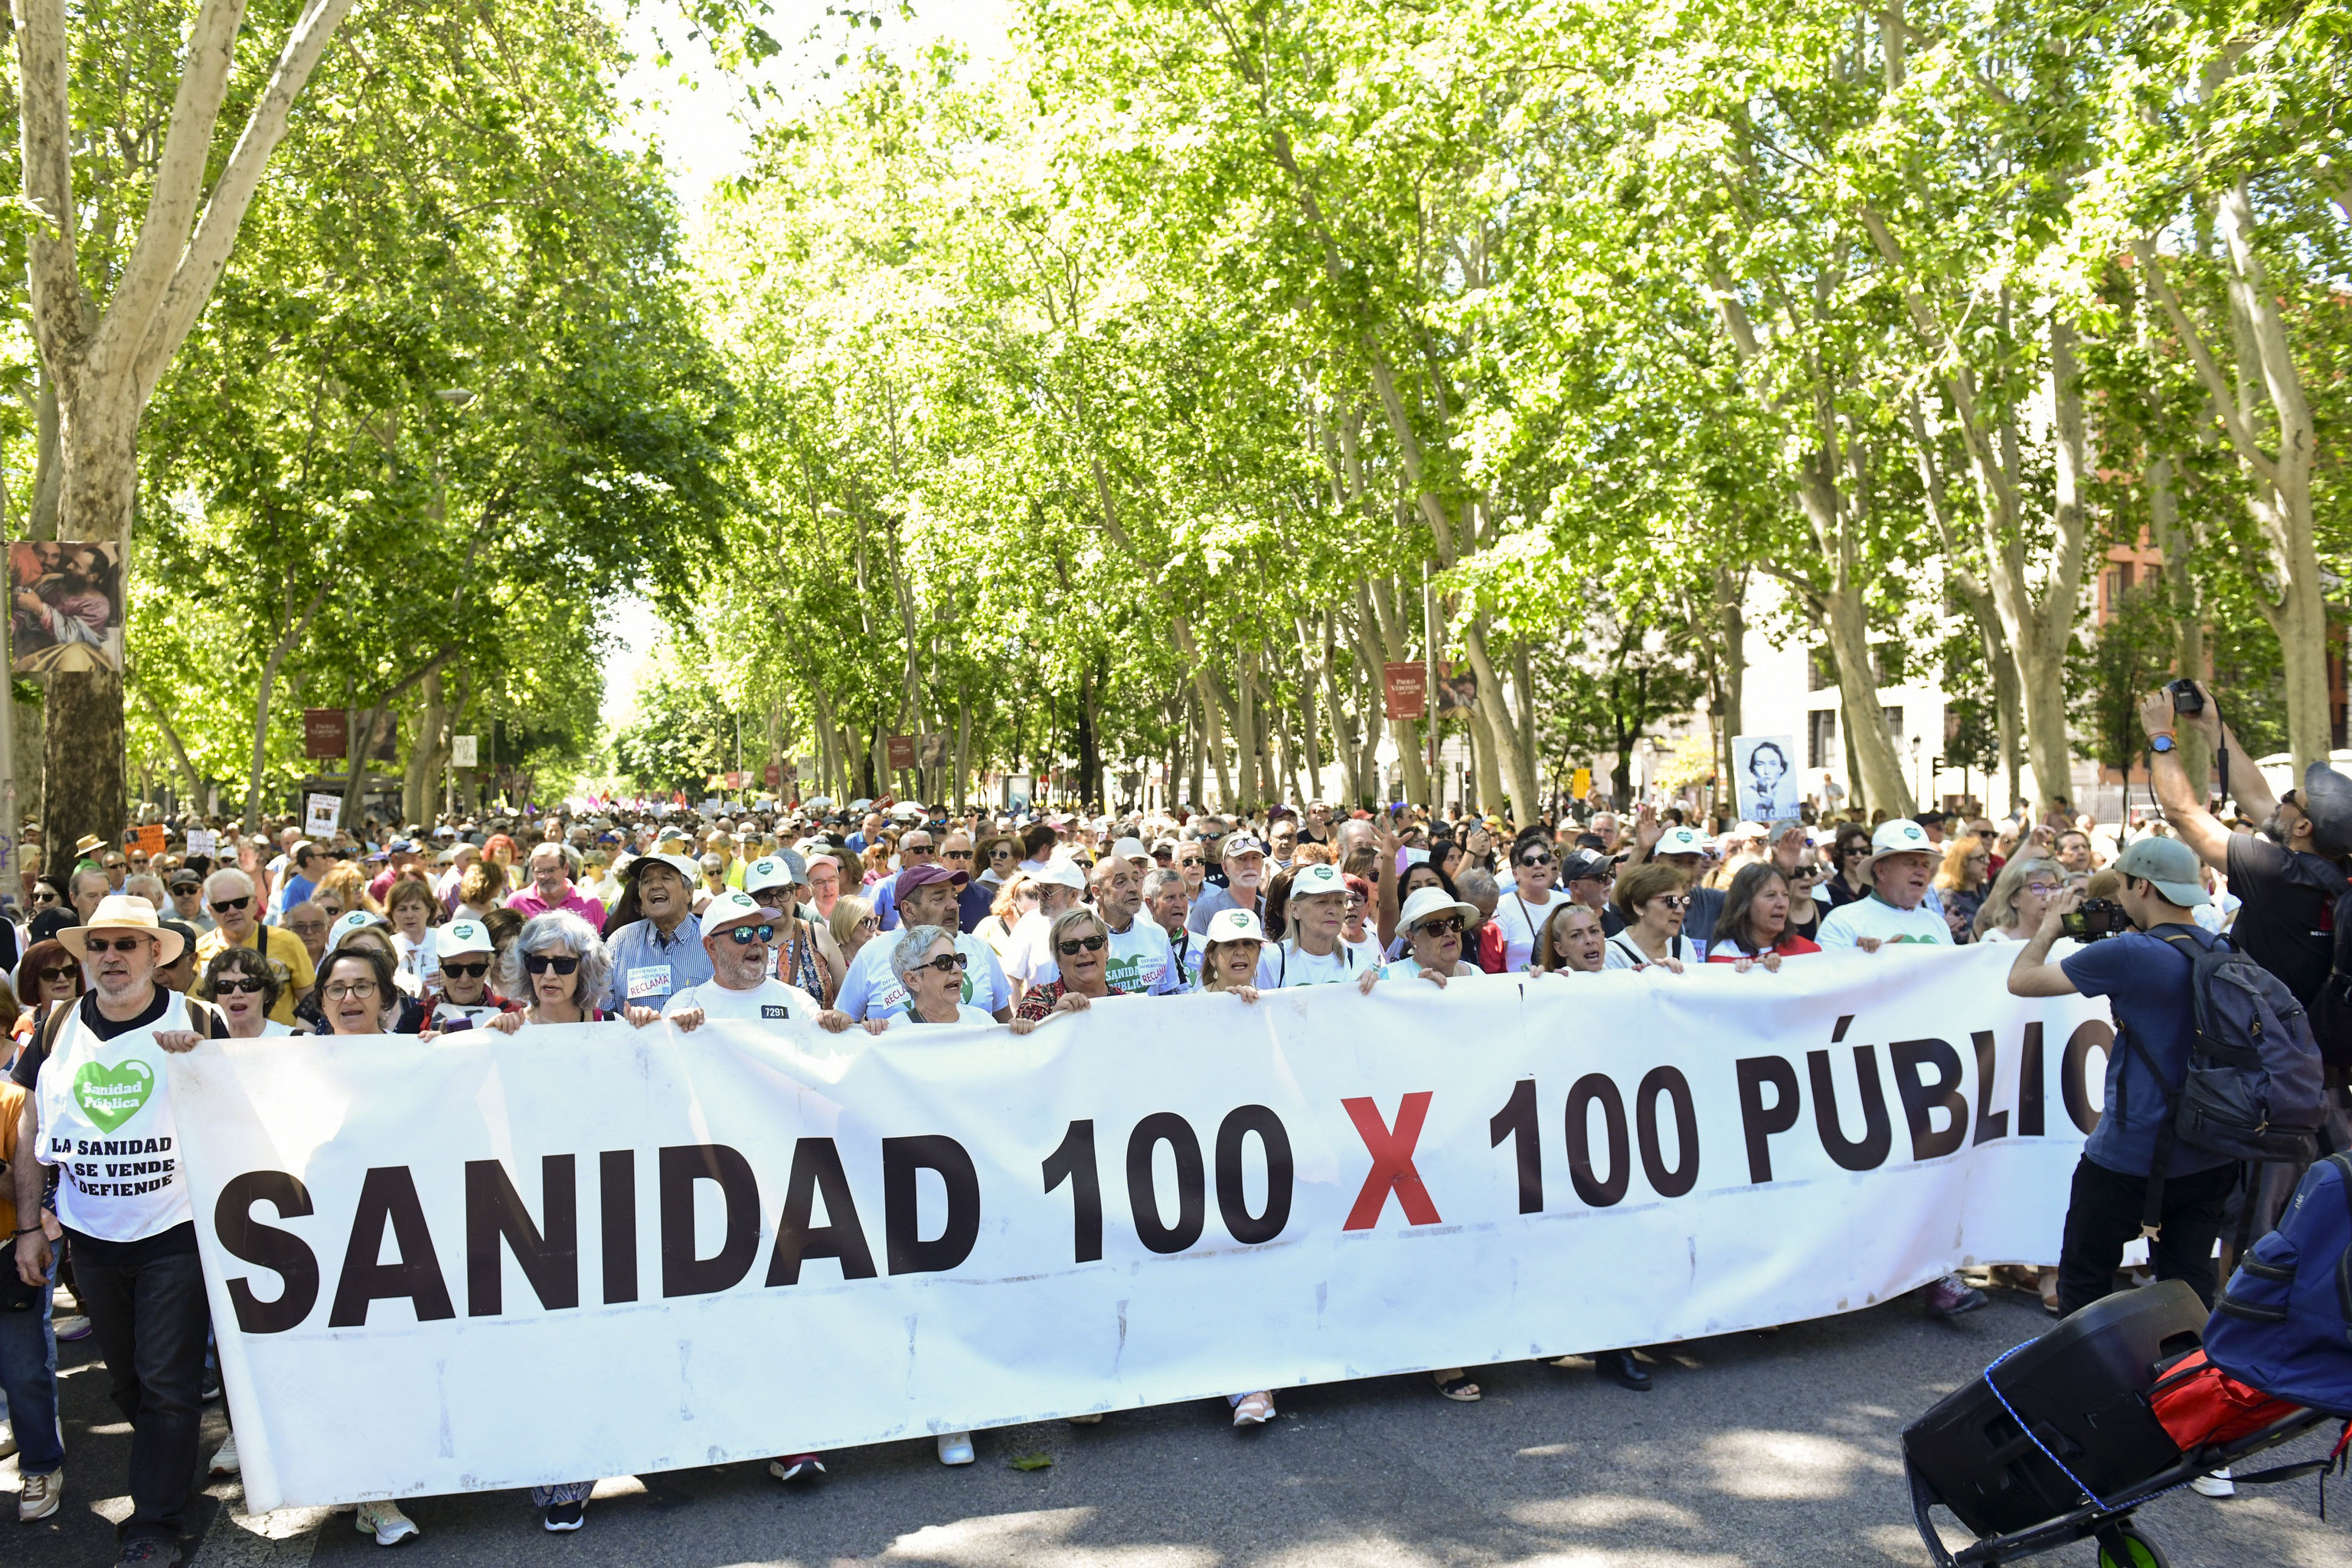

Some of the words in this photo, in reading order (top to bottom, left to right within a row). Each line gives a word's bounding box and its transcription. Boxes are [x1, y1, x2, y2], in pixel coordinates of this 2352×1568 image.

[1106, 966, 1138, 982] SANIDA
[630, 975, 669, 996] RECLAMA
[884, 987, 906, 1006] RECLA
[765, 1008, 784, 1017] 7291
[83, 1081, 142, 1096] Sanidad
[84, 1096, 139, 1110] Pública
[51, 1138, 72, 1154] LA
[77, 1137, 172, 1155] SANIDAD
[74, 1163, 98, 1178] SE
[106, 1158, 175, 1178] VENDE
[214, 1135, 981, 1334] SANIDAD
[1041, 1104, 1294, 1264] 100
[1340, 1091, 1442, 1231] X
[1489, 1065, 1700, 1215] 100
[1735, 1014, 2116, 1184] PÚBLIC
[79, 1174, 173, 1197] DEFIENDE
